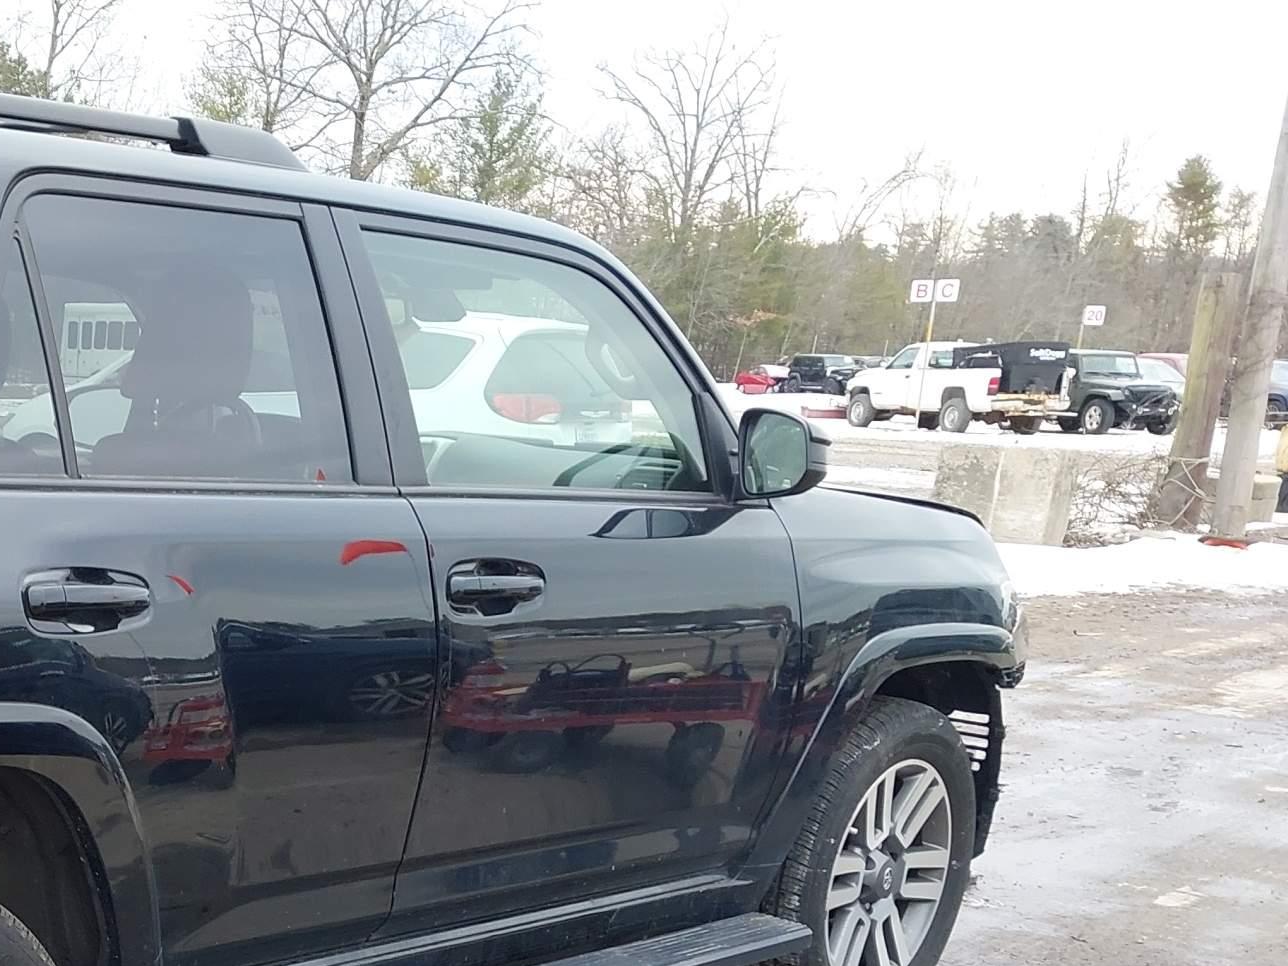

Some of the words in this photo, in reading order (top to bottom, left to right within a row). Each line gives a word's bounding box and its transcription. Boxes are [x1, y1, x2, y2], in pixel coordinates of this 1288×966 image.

[915, 283, 929, 298] B
[941, 282, 954, 298] C
[1087, 310, 1103, 321] 20
